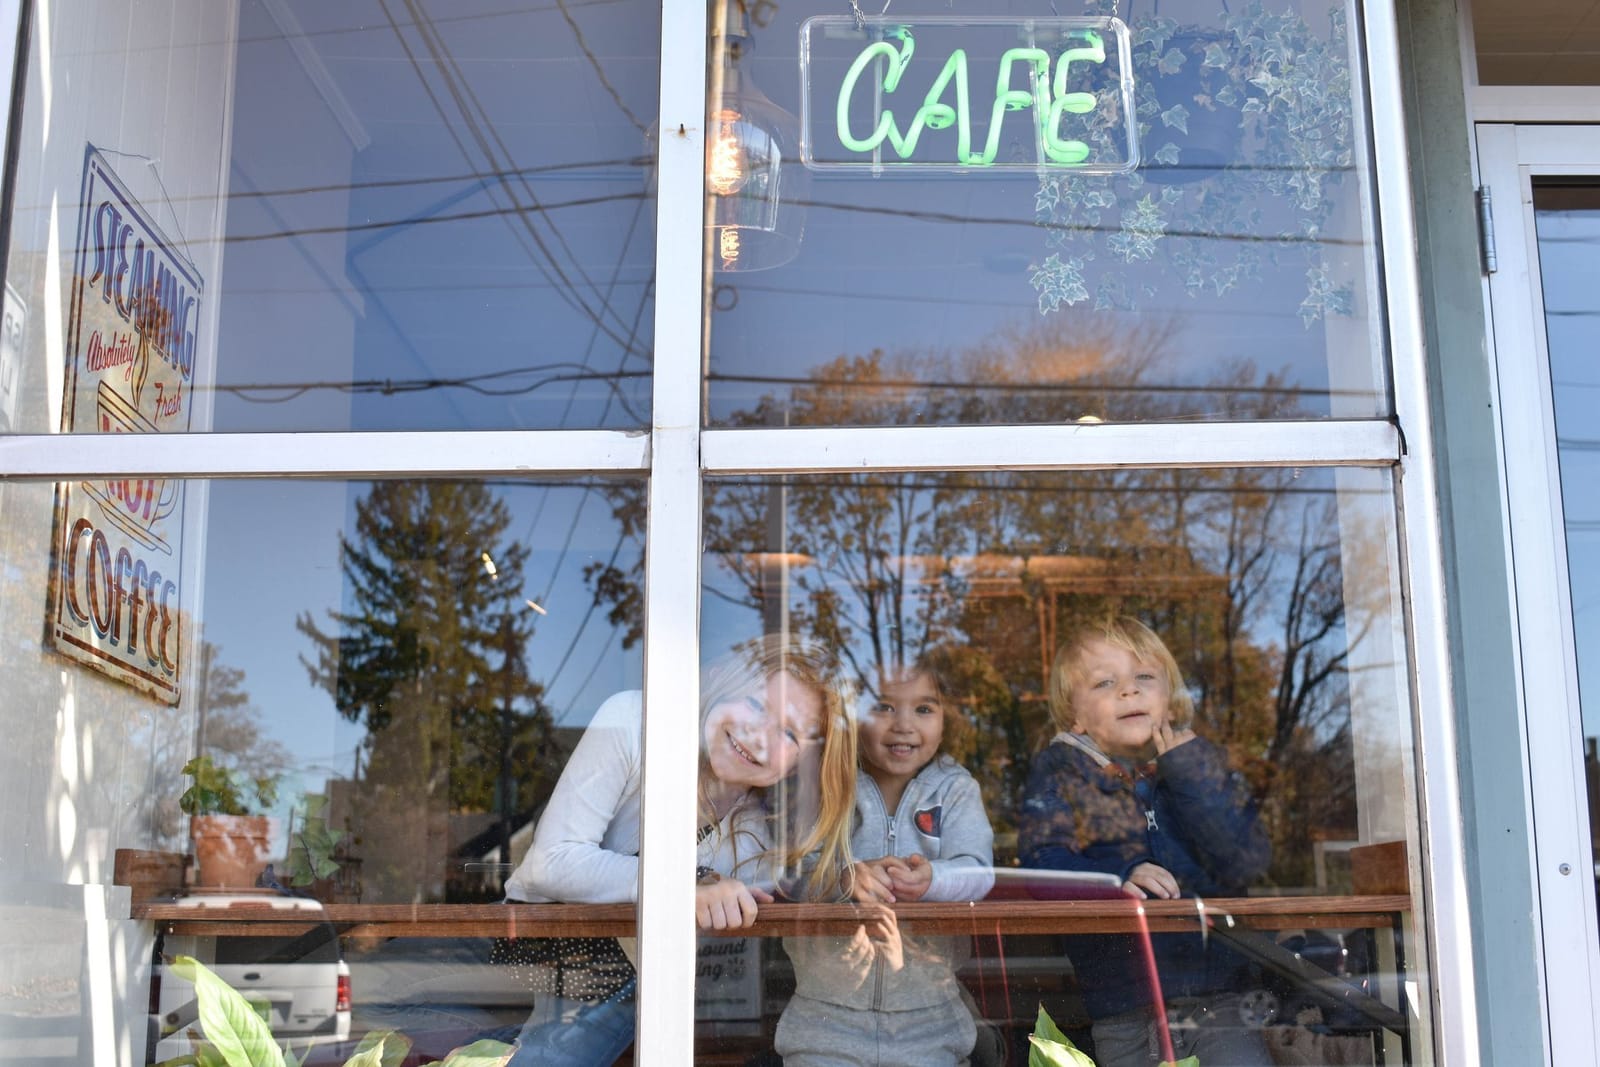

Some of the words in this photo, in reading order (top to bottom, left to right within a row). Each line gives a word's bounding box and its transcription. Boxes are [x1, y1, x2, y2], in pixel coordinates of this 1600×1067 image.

[837, 27, 1106, 165] CAFE
[89, 200, 195, 381] STEAMING
[86, 330, 135, 382] Absolutely
[154, 379, 182, 425] Fresh
